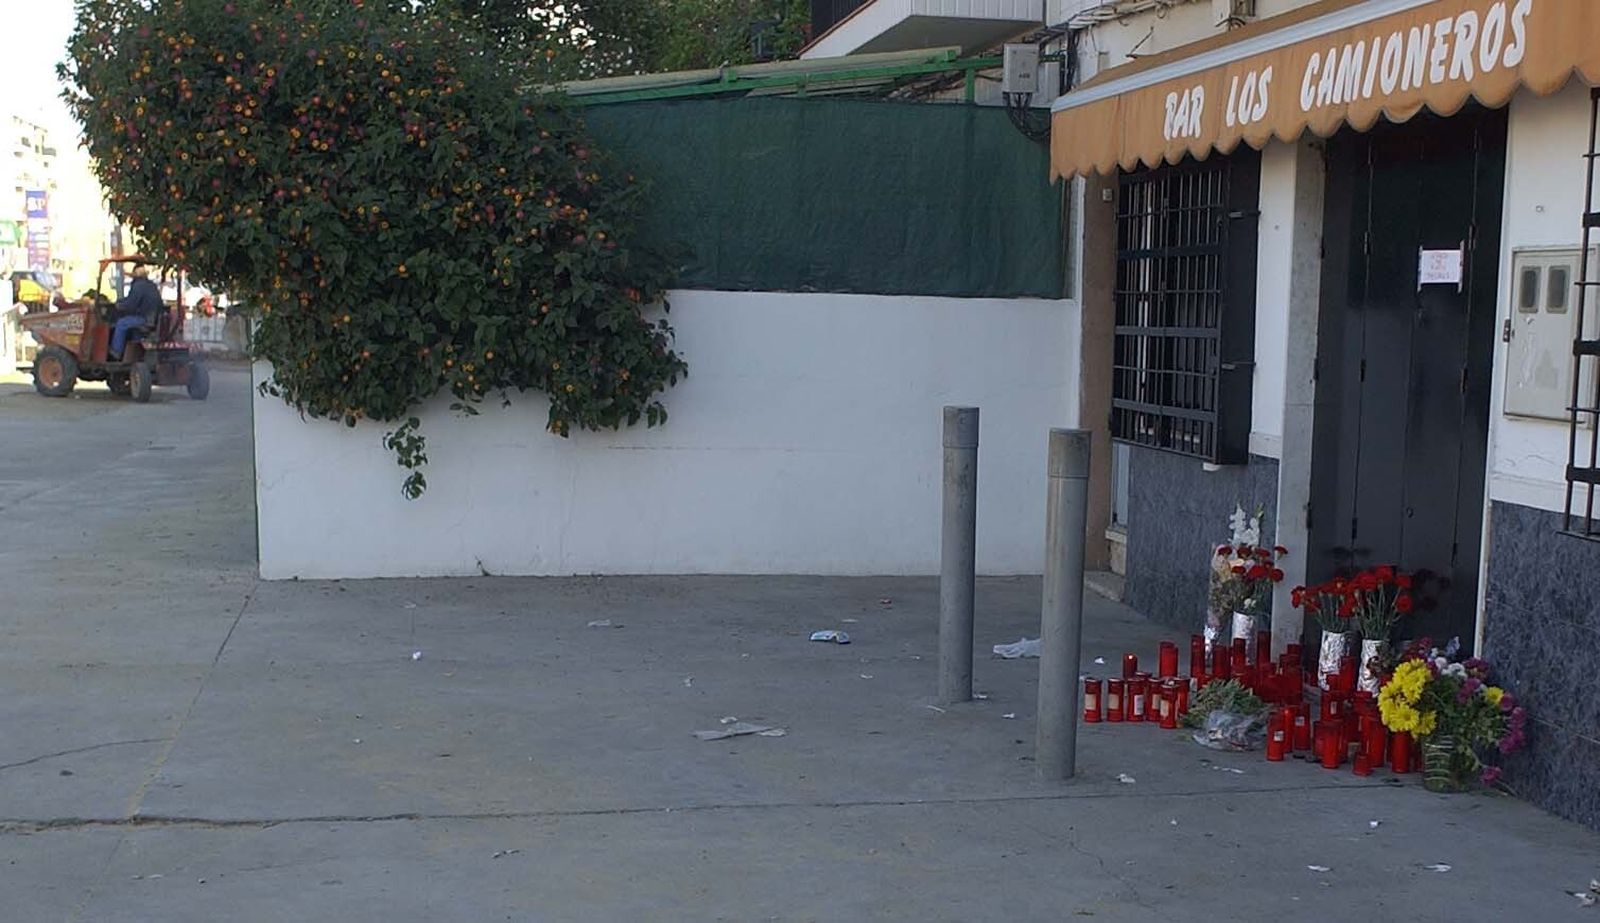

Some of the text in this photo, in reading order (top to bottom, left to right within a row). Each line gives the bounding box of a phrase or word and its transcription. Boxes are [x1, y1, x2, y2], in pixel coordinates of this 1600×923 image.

[1163, 0, 1531, 141] BAR LOS CAMIONEROS
